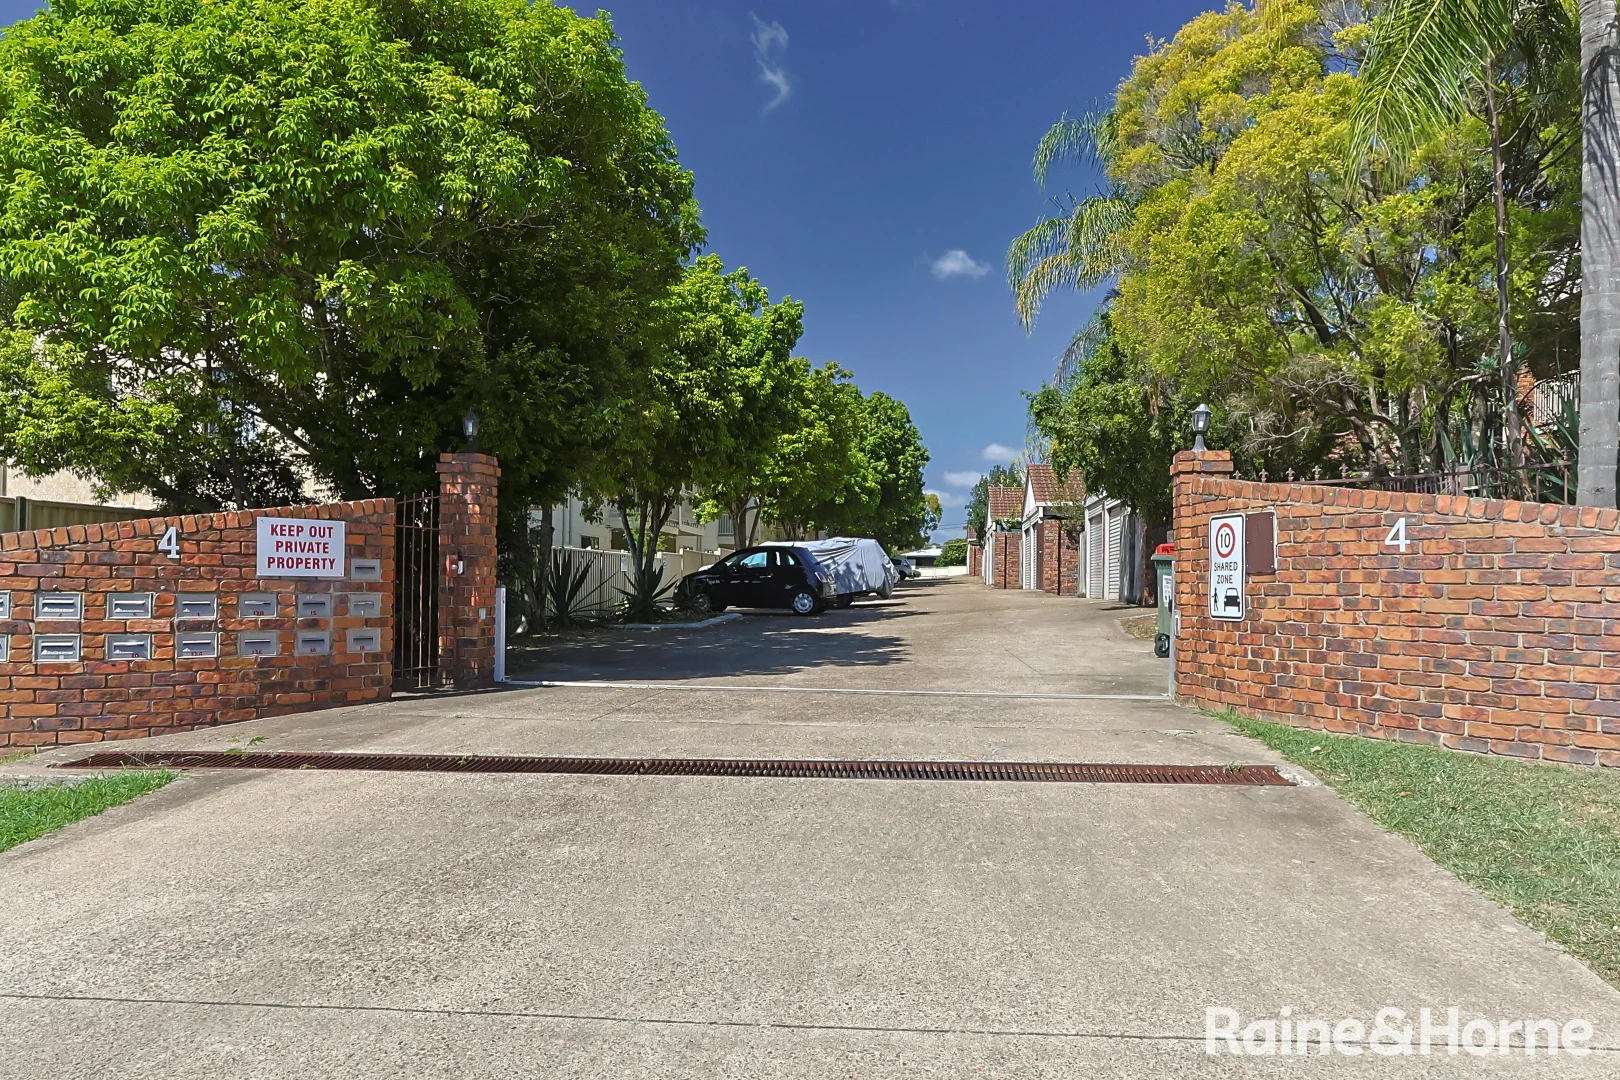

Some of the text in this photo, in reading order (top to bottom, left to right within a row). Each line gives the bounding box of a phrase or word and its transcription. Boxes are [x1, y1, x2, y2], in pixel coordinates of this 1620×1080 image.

[270, 524, 334, 538] KEEP OUT
[1384, 517, 1411, 553] 4
[158, 526, 180, 559] 4
[275, 540, 330, 554] PRIVATE
[1220, 532, 1231, 549] 10
[267, 556, 336, 570] PROPERTY
[1213, 561, 1238, 572] SHARED
[1216, 574, 1234, 585] ZONE
